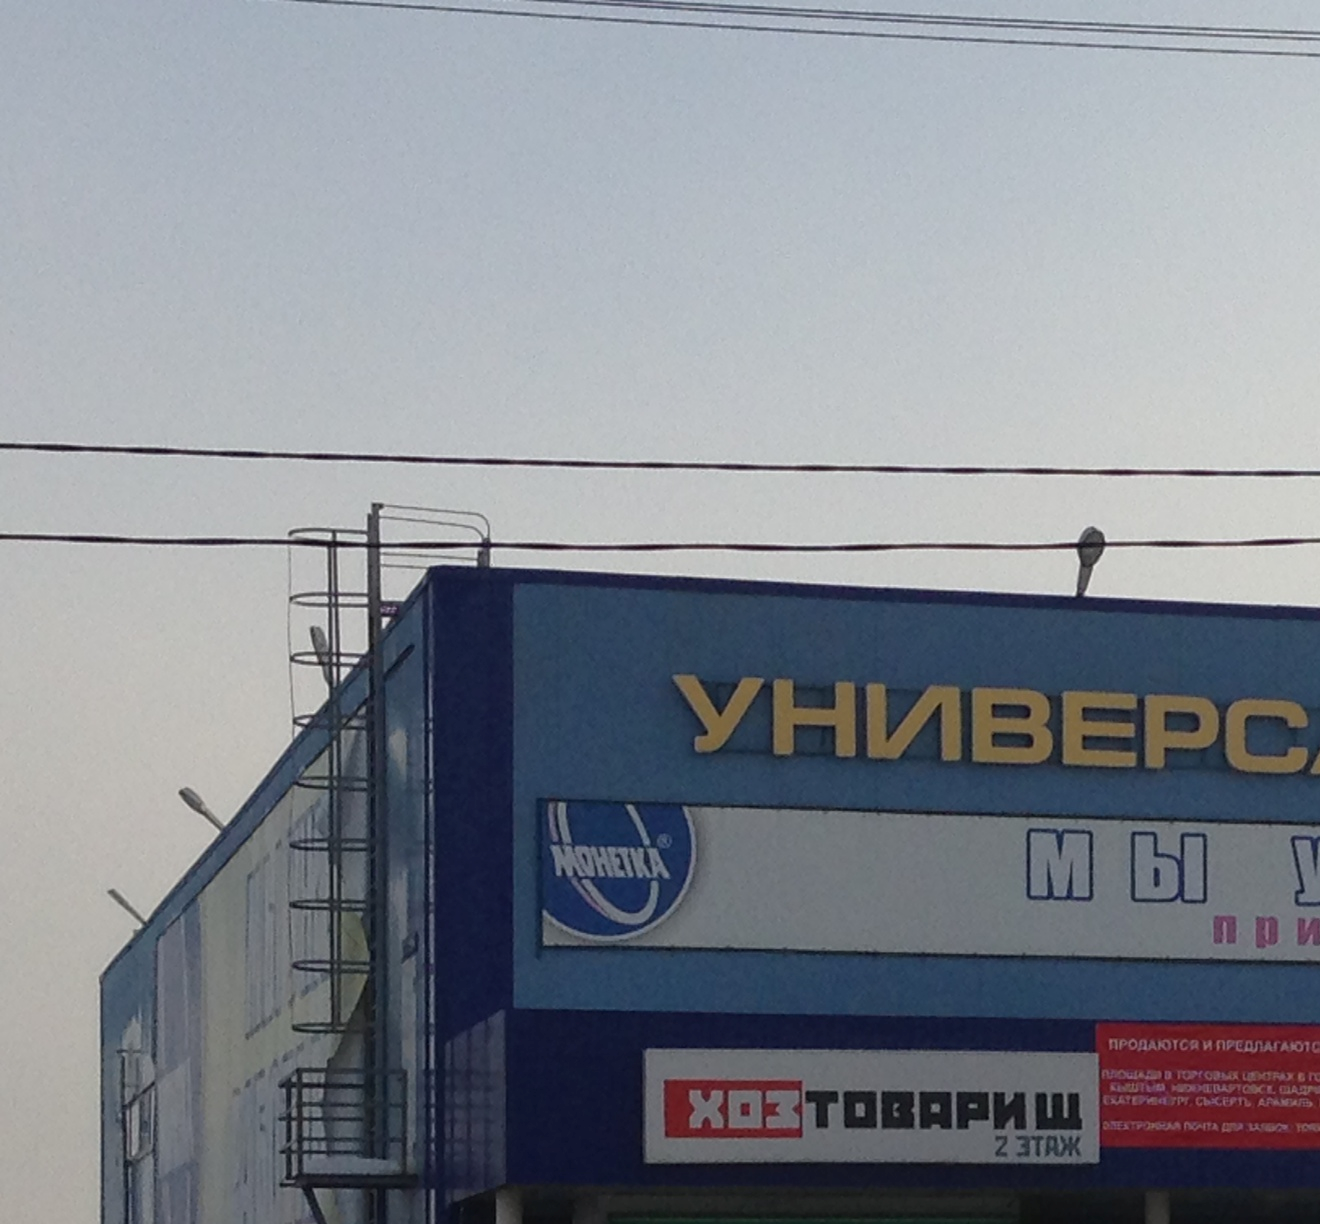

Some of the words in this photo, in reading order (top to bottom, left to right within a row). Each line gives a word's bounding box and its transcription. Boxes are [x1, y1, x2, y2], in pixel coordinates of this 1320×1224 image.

[549, 844, 672, 880] МОНЕТКА
[1026, 828, 1208, 903] МЫ
[1108, 1038, 1201, 1053] ПРОДАЮТСЯ
[1202, 1039, 1213, 1051] И
[994, 1134, 1009, 1157] 2
[1015, 1134, 1082, 1158] ЭТАЖ
